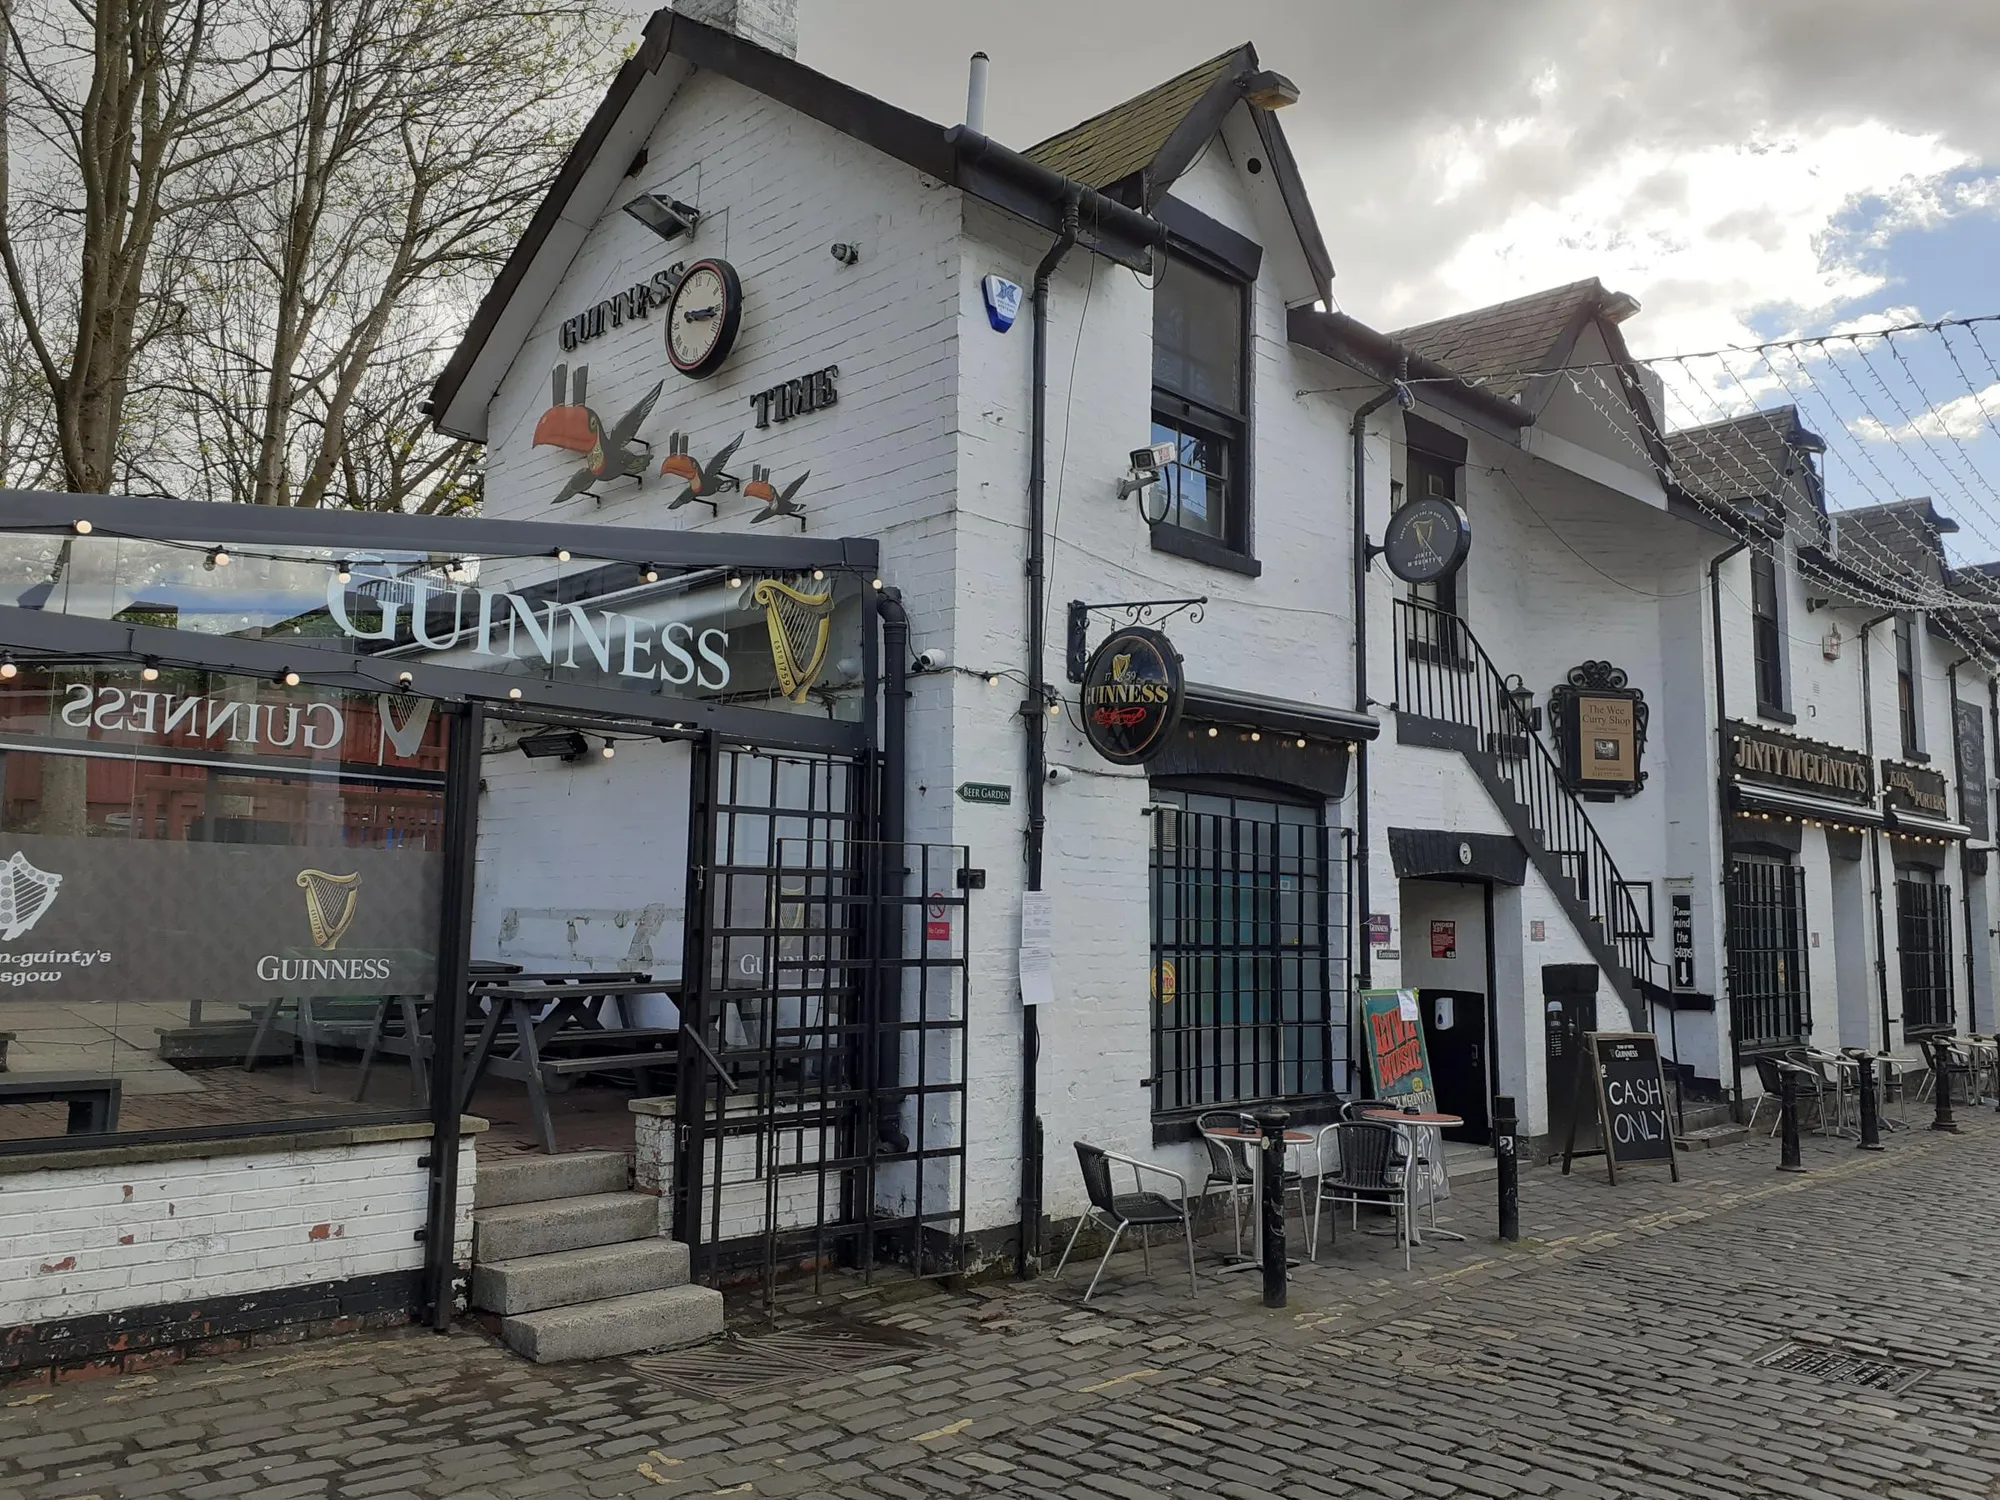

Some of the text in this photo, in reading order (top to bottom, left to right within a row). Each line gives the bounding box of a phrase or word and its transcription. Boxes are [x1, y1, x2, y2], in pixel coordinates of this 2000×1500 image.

[559, 261, 685, 352] GUINNESS
[750, 365, 839, 429] TIME
[327, 553, 730, 691] GUINNESS
[1085, 683, 1169, 705] GUINNESS
[1582, 714, 1631, 727] Curry Shop
[1588, 705, 1625, 715] The Wee
[963, 786, 1009, 800] BEER GARDEN
[1888, 771, 1910, 787] ALES
[1915, 791, 1946, 811] PORTERS
[1673, 917, 1691, 928] mind
[1676, 931, 1689, 943] the
[1674, 946, 1693, 961] steps
[256, 955, 390, 981] GUINNESS
[1378, 1038, 1424, 1090] MUSIC
[1615, 1050, 1638, 1058] GUINNESS
[1609, 1078, 1662, 1105] CASH
[1614, 1110, 1665, 1144] ONLY
